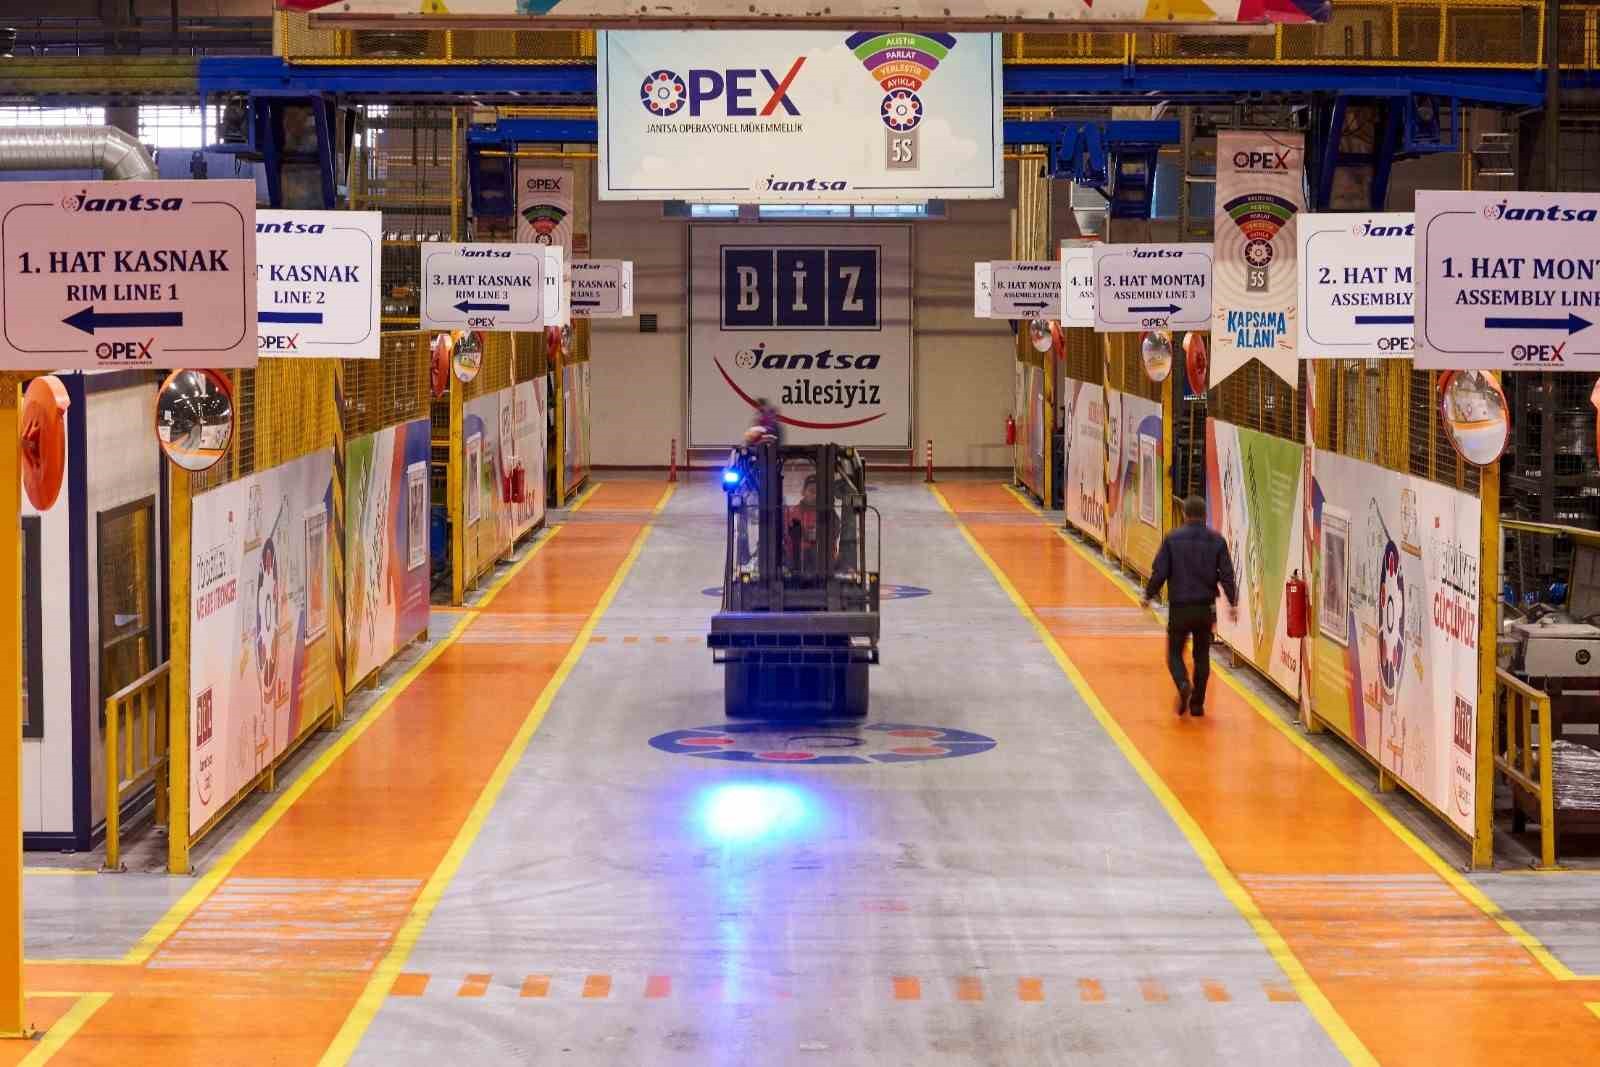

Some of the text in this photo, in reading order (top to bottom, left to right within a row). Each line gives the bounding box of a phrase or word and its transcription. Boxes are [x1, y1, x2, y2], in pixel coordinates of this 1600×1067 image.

[886, 51, 916, 59] PARLAT
[640, 56, 807, 117] OPEX
[679, 123, 736, 133] OPERASYONEL
[891, 138, 913, 162] 5S
[1233, 149, 1291, 169] OPEX
[765, 175, 848, 192] jantsa
[76, 190, 183, 212] jantsa
[1499, 200, 1598, 222] jantsa
[461, 247, 511, 258] jantsa
[1132, 247, 1183, 258] jantsa
[19, 250, 230, 273] 1. HAT KASNAK
[1442, 258, 1463, 278] 1.
[1471, 258, 1525, 278] HAT
[270, 265, 360, 283] KASNAK
[433, 275, 531, 287] 3. HAT KASNAK
[1104, 274, 1205, 287] 3. HAT MONTAJ
[1251, 271, 1265, 287] 5S
[1319, 268, 1337, 284] 2.
[1344, 267, 1387, 284] HAT
[67, 284, 179, 301] RIM LINE 1
[578, 280, 616, 289] KASNAK
[1008, 281, 1026, 289] HAT
[274, 291, 325, 304] LINE 2
[456, 291, 474, 299] RIM
[477, 291, 500, 299] LINE
[1114, 290, 1163, 299] ASSEMBLY
[1166, 290, 1188, 299] LINE
[1331, 292, 1413, 305] ASSEMBLY
[1456, 290, 1556, 306] ASSEMBLY
[1227, 311, 1286, 334] KAPSAMA
[1236, 329, 1275, 348] ALANI
[96, 338, 154, 360] OPEX
[750, 342, 881, 369] jantsa
[1511, 342, 1565, 362] OPEX
[781, 379, 881, 408] ailesiyiz
[1434, 587, 1475, 648] GÜÇLÜYÜZ
